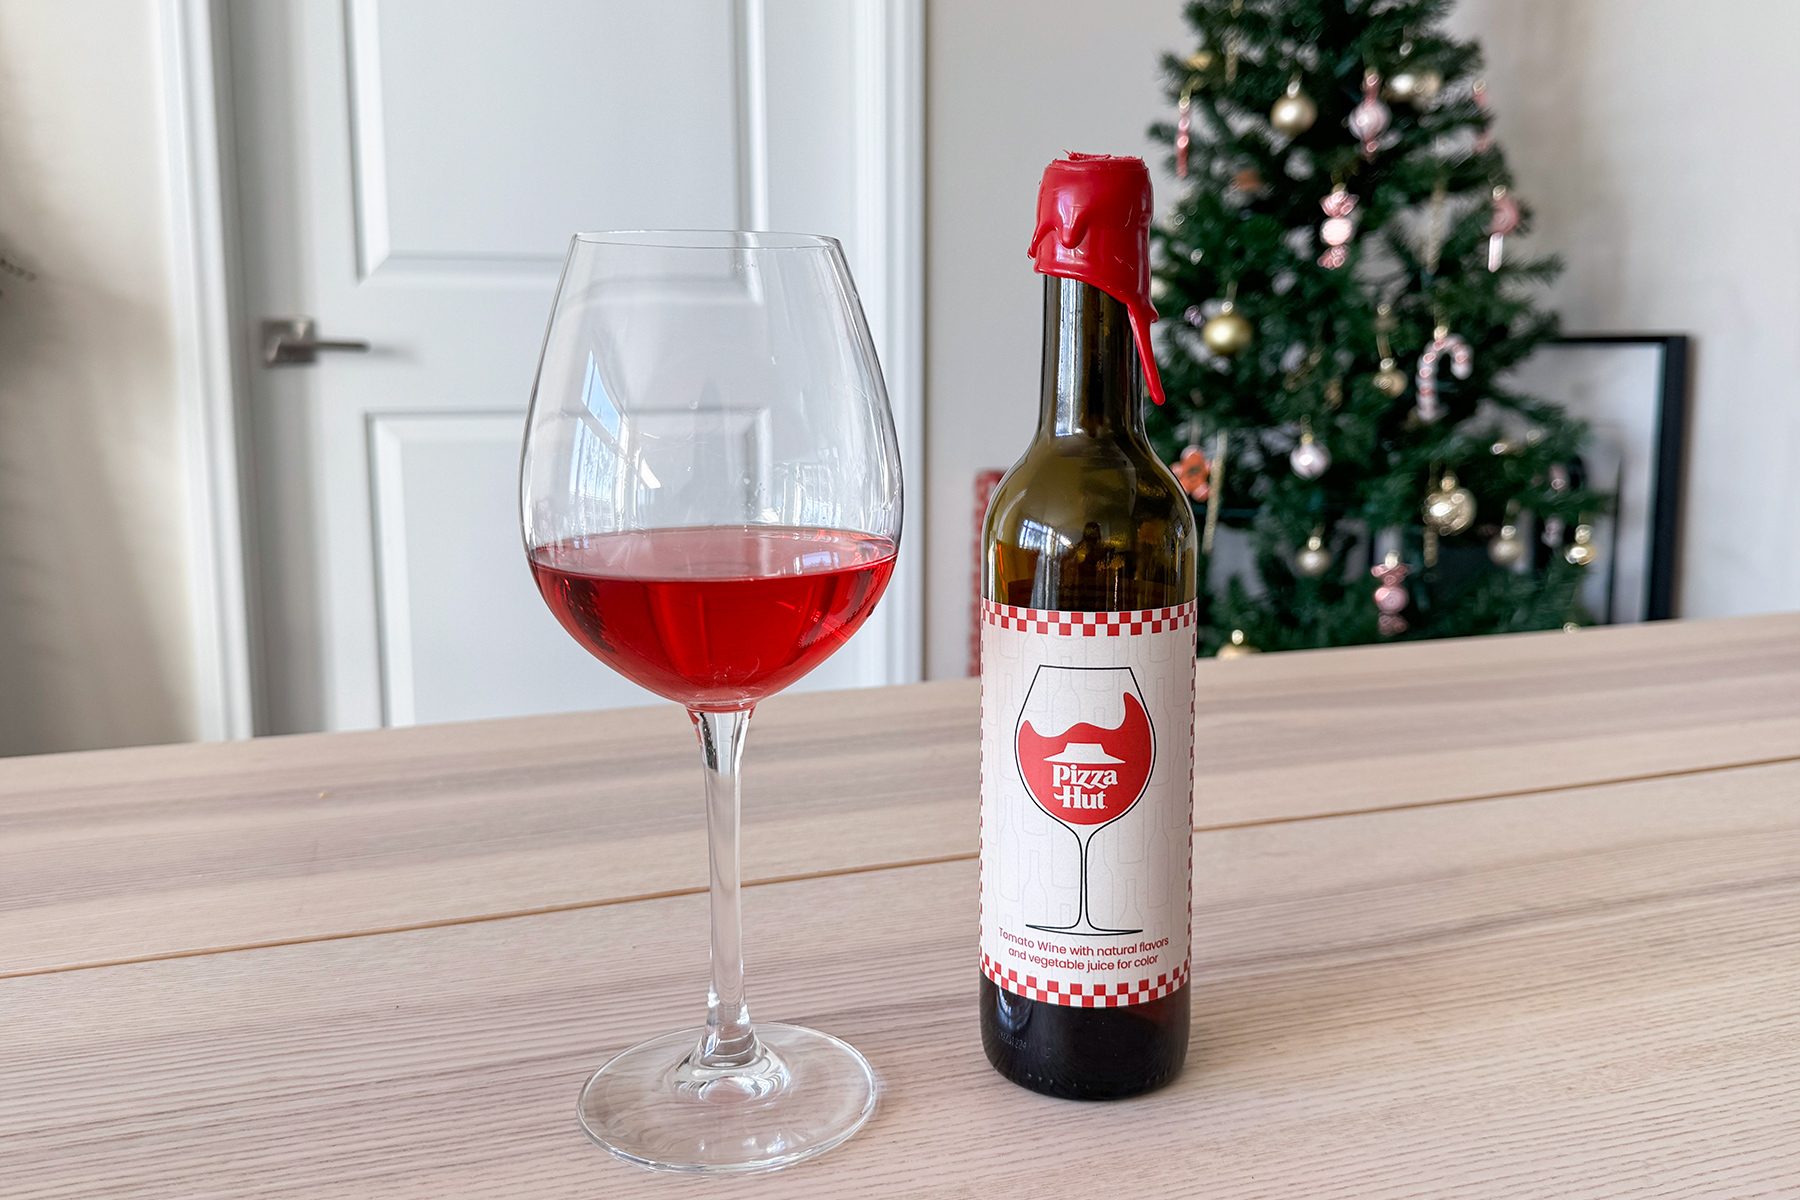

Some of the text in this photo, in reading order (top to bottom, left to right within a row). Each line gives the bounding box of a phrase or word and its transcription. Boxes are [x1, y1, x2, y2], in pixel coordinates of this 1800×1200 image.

[1052, 764, 1118, 789] Pizza
[1053, 785, 1107, 809] Hut
[999, 927, 1169, 956] Tomato Wine with natural flavors
[1008, 947, 1158, 973] and vegetable juice for color
